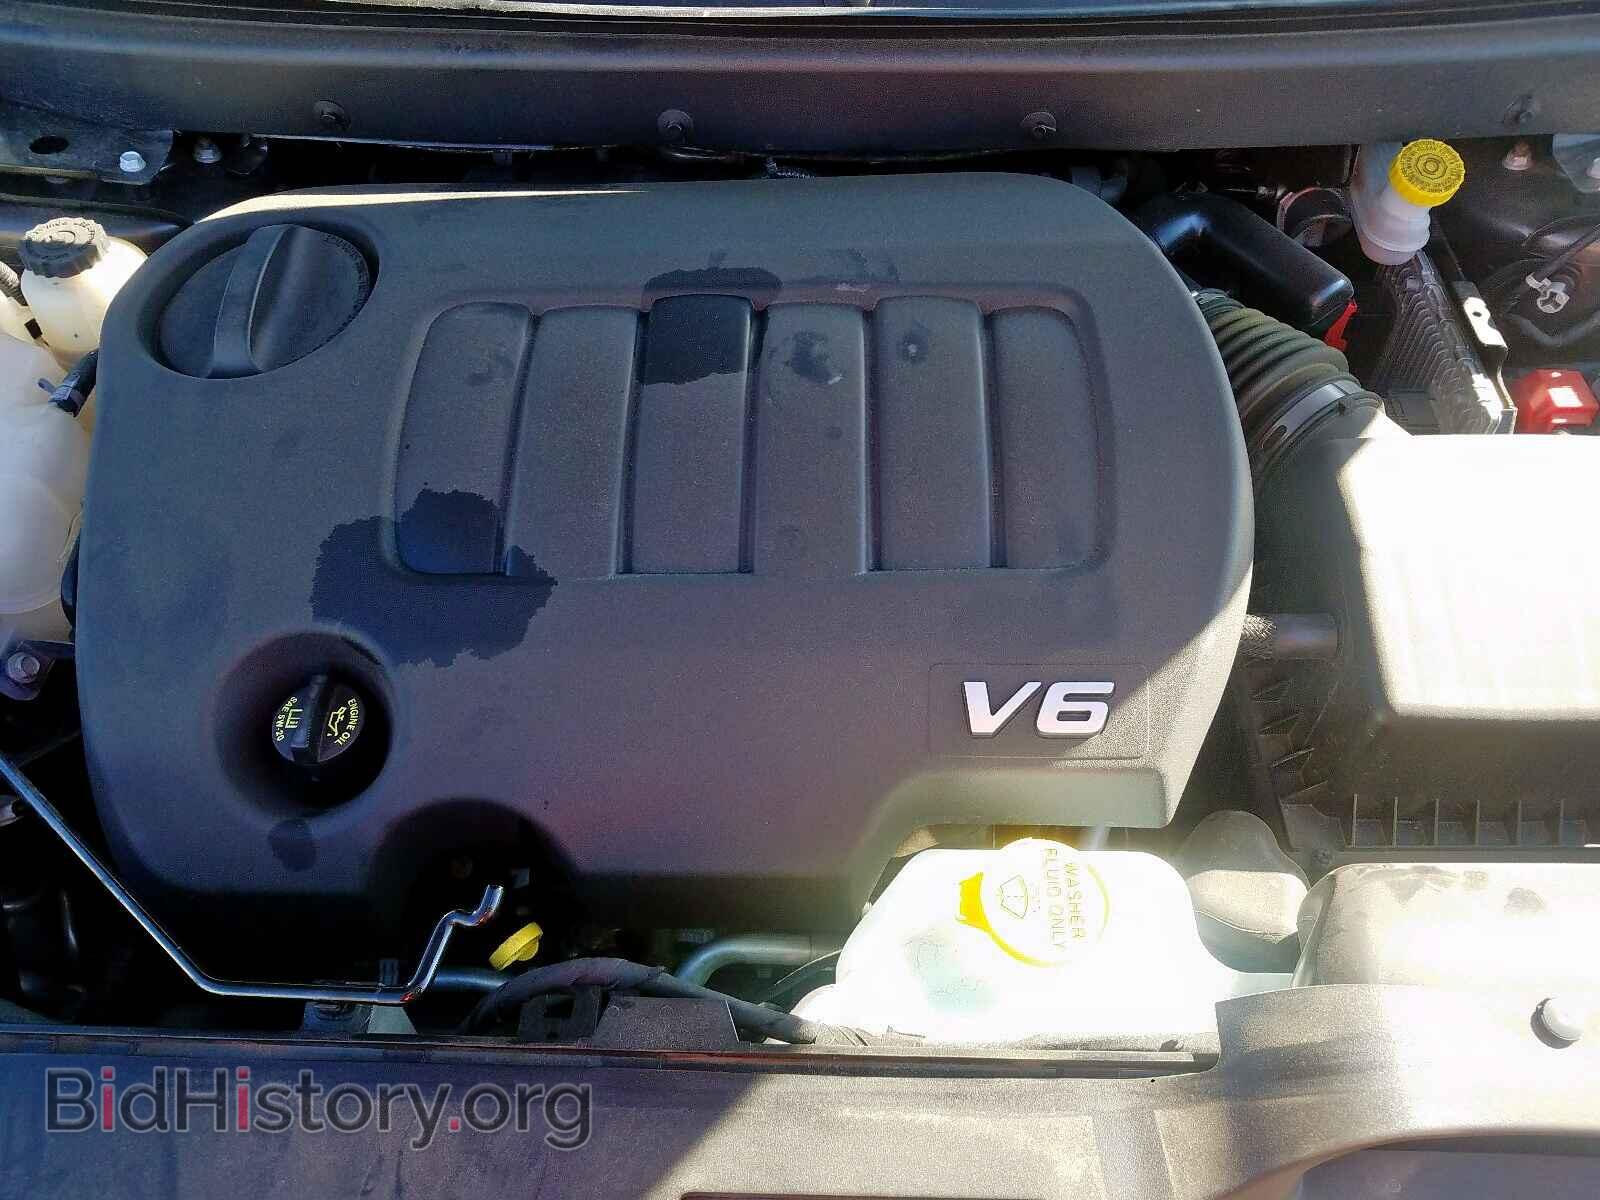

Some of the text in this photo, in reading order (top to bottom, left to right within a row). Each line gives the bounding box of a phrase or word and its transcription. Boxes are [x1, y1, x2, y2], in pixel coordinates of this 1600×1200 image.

[275, 696, 298, 742] SAE 5W-20
[334, 698, 359, 746] ENGINE OIL
[962, 681, 1115, 738] V6
[1045, 848, 1066, 949] FLUID ONLY
[1064, 862, 1087, 938] WASHER
